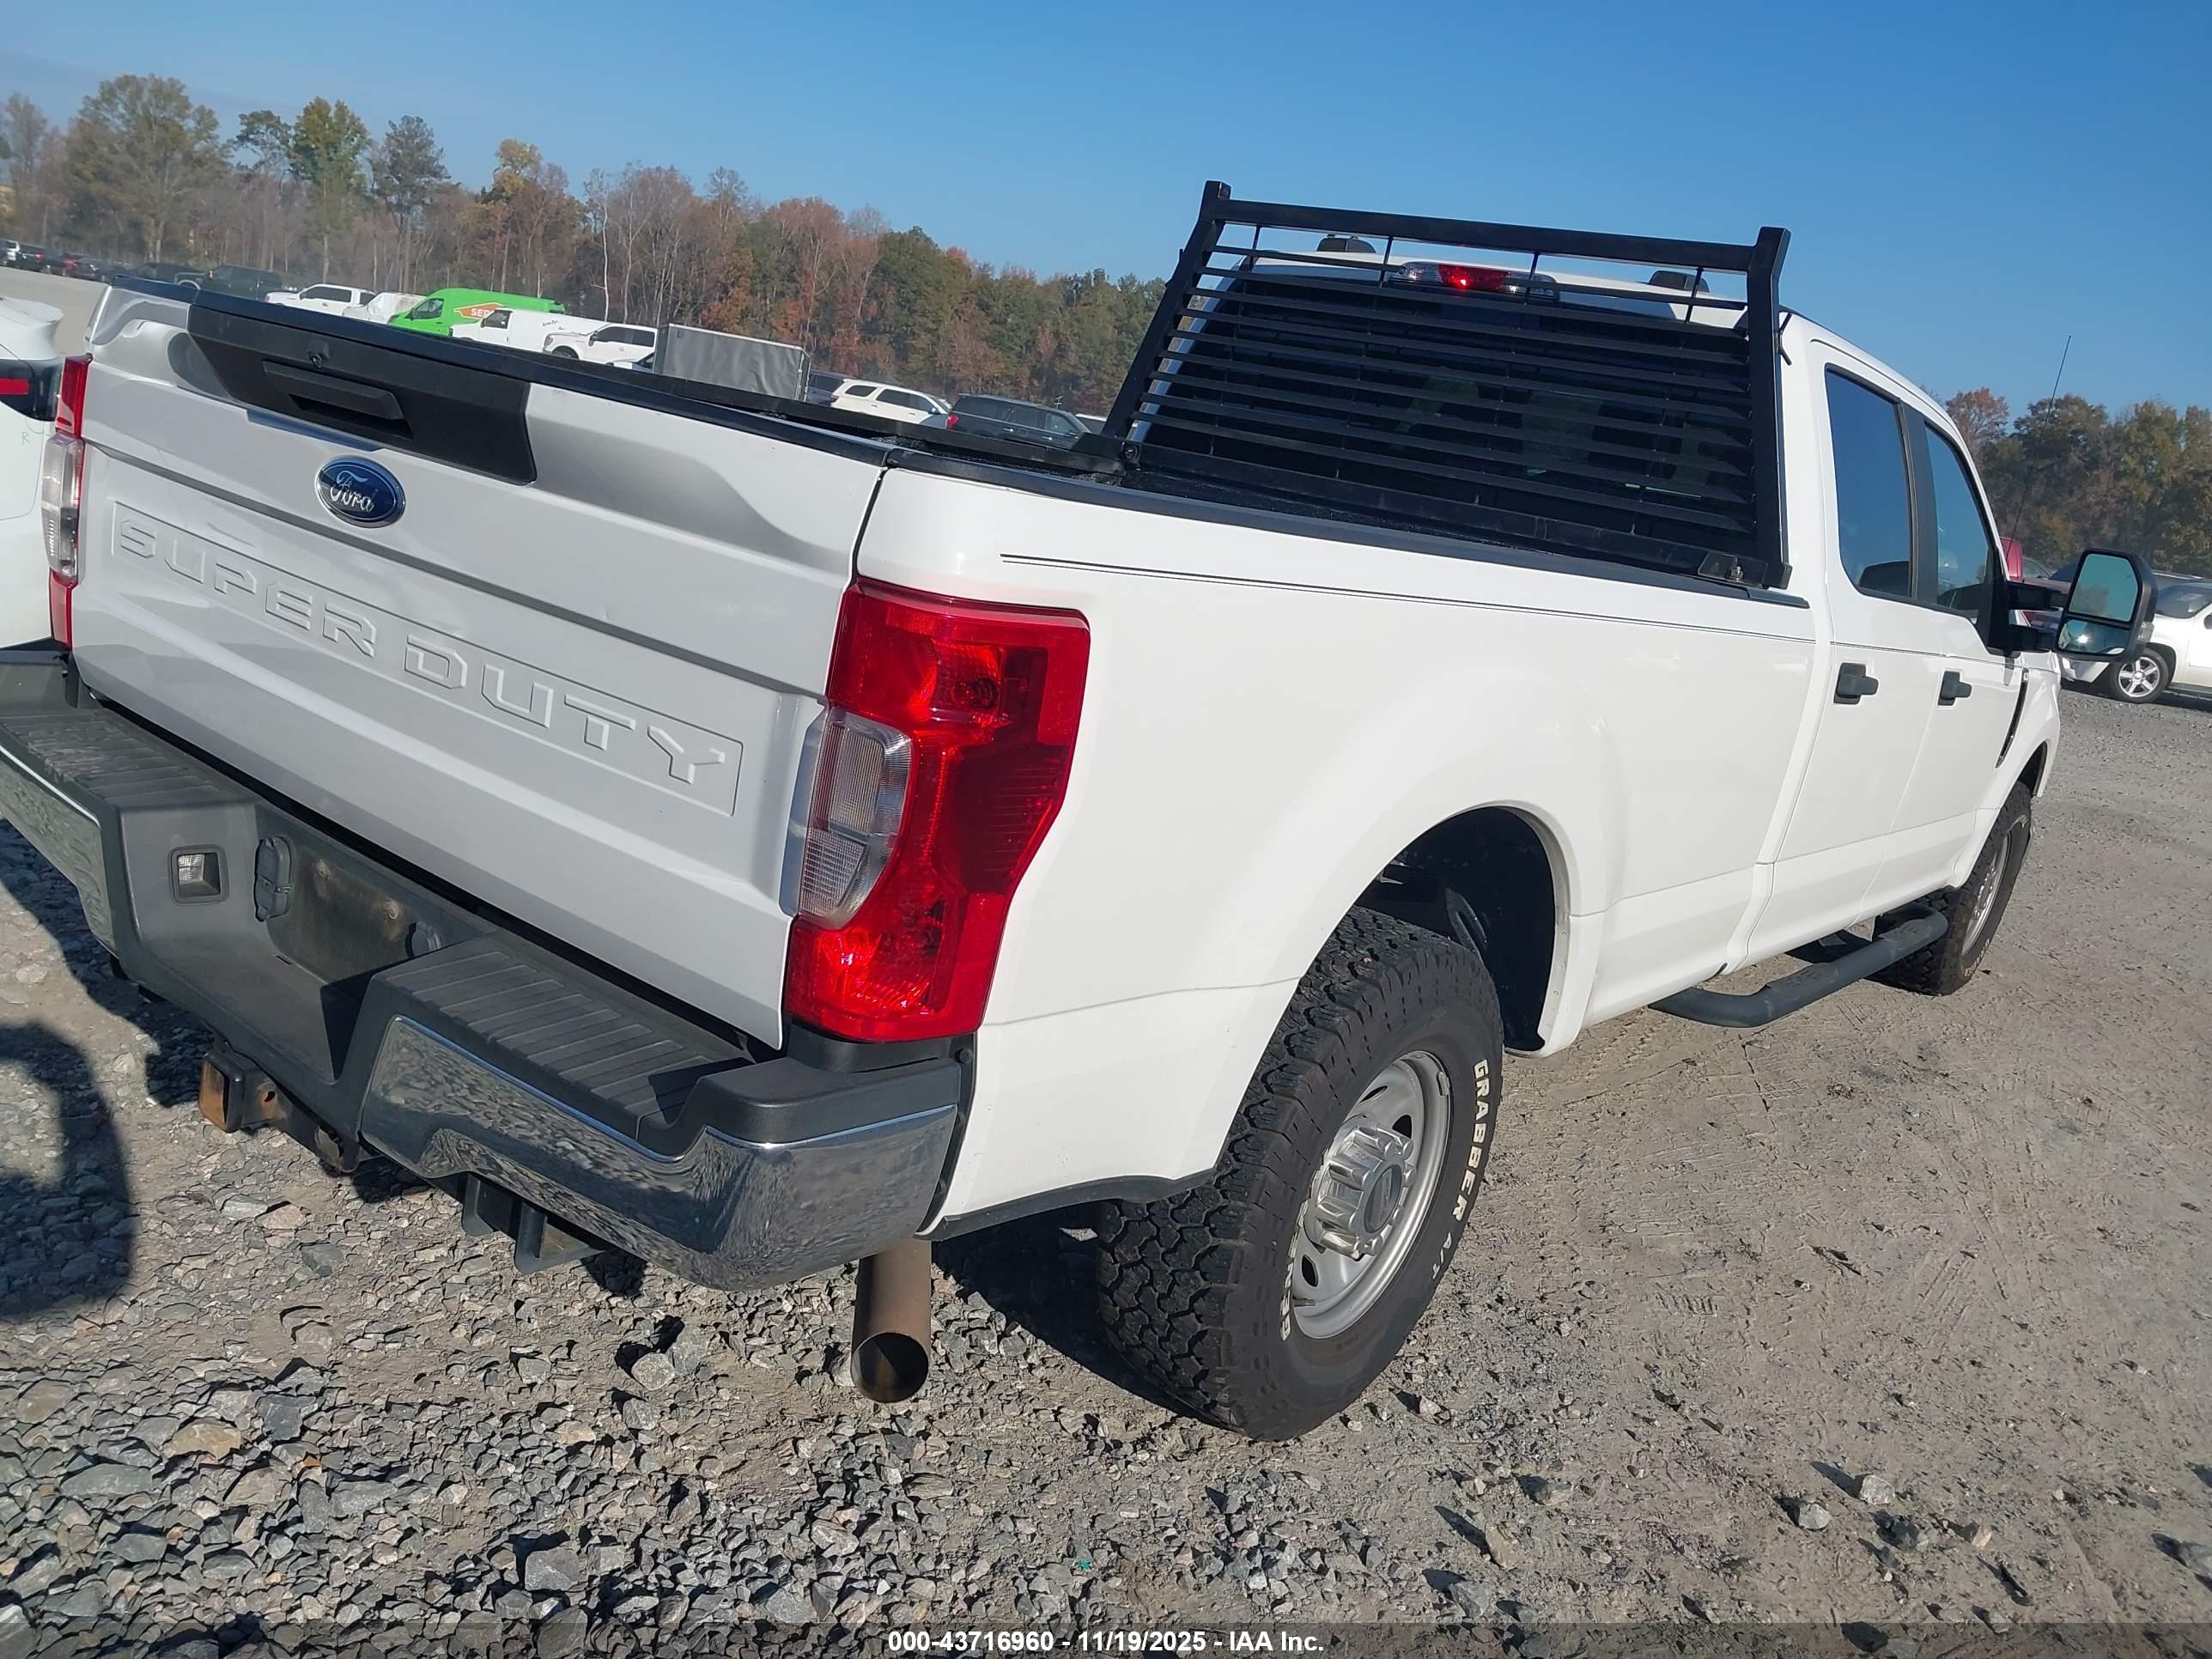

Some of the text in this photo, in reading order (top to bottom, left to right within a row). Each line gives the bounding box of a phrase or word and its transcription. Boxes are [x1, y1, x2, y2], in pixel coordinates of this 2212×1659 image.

[329, 470, 378, 513] Ford
[120, 520, 725, 784] SUPER DUTY
[1452, 1059, 1490, 1221] GRABBER
